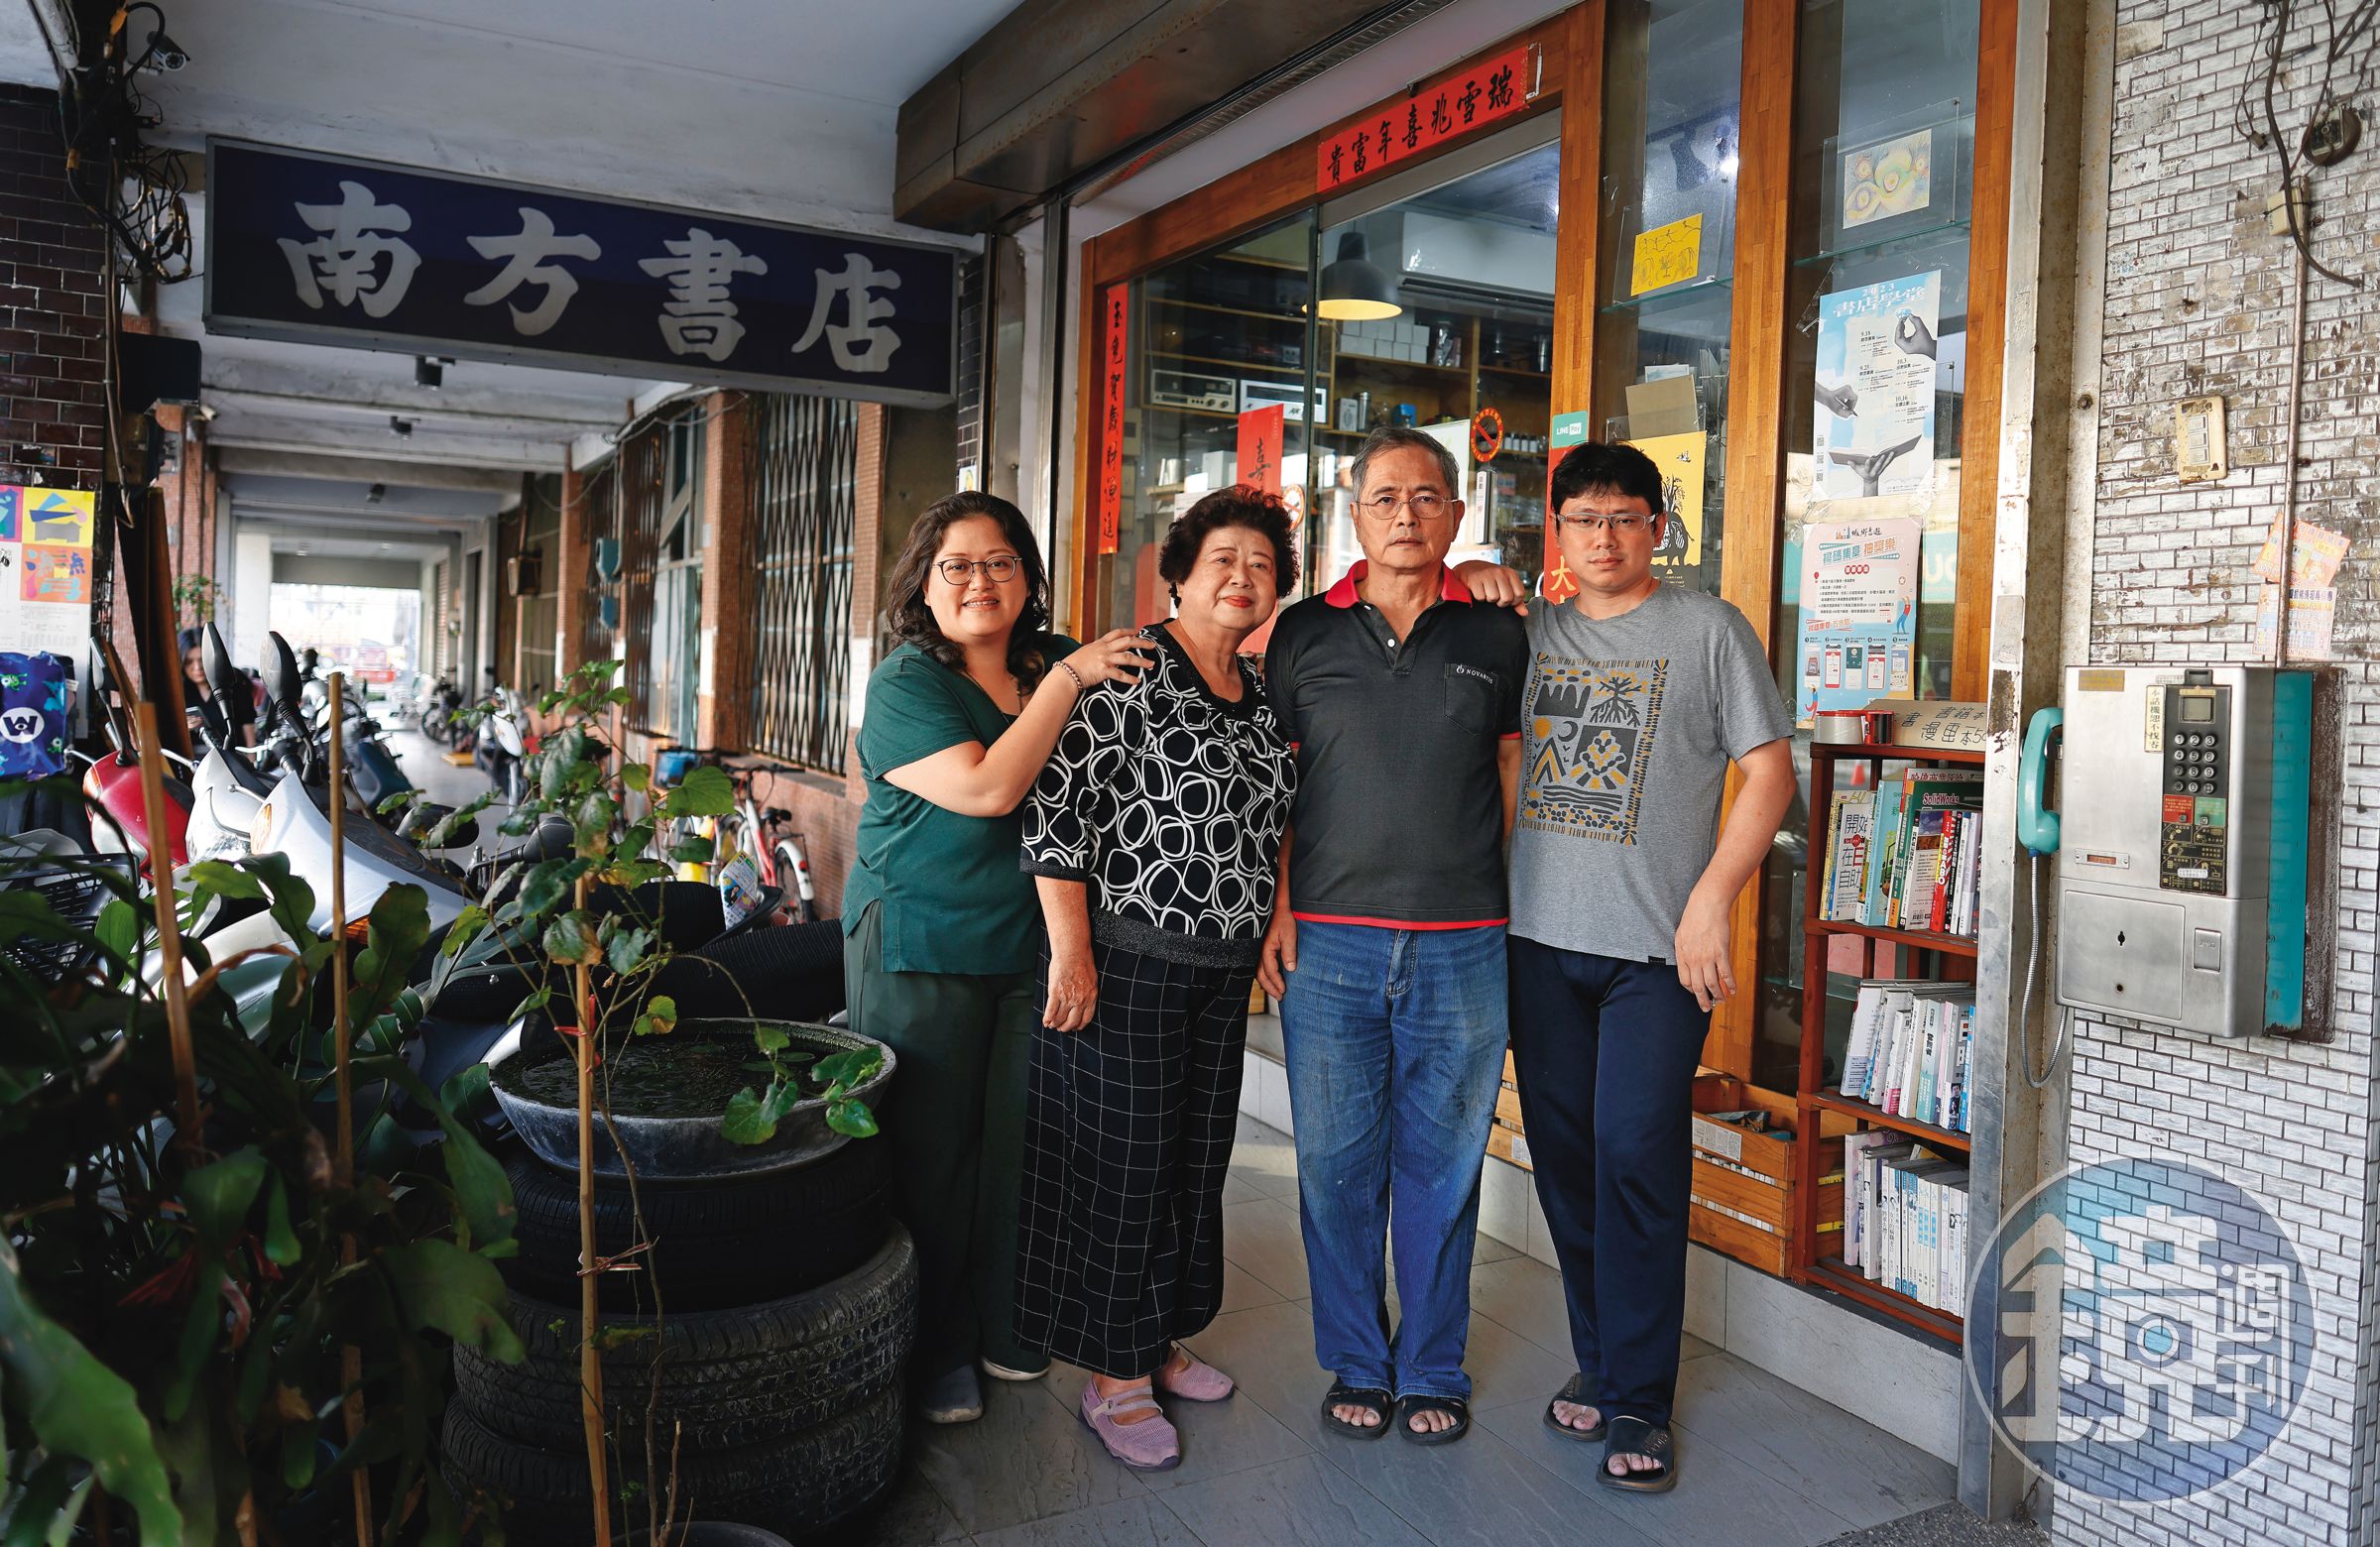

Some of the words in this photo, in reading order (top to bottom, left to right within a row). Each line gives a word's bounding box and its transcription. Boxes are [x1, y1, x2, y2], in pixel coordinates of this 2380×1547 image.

[277, 180, 904, 373] 南方書店
[1556, 426, 1569, 435] LINE
[1571, 424, 1581, 434] Pay
[1467, 668, 1493, 684] NOVARTIS
[1923, 793, 1960, 805] SolidWorks
[1845, 814, 1868, 834] 開始
[1839, 870, 1860, 889] 自助
